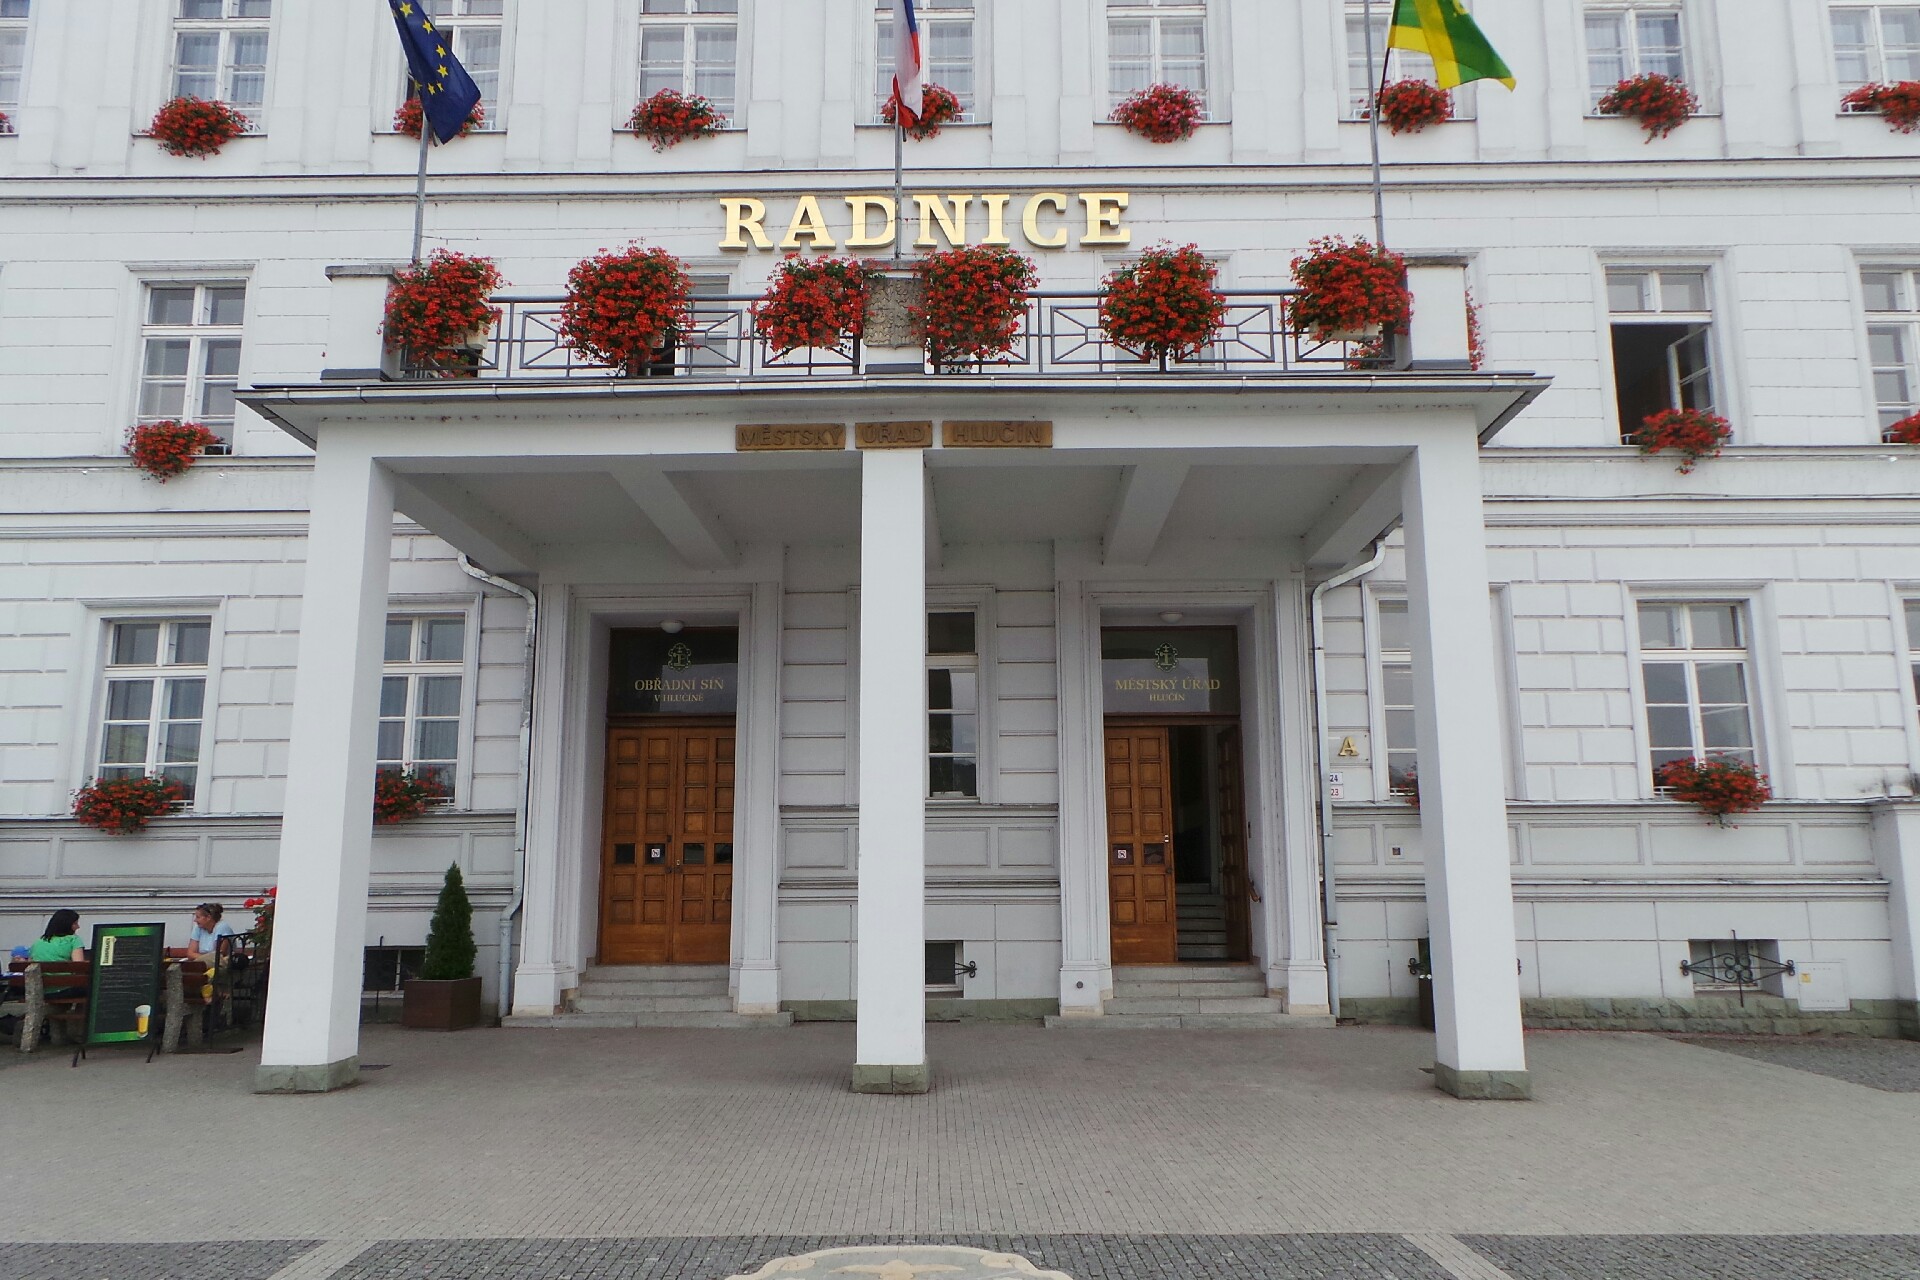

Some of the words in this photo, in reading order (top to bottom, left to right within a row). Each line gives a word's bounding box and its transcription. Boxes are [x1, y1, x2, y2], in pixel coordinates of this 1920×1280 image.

[719, 193, 1131, 251] RADNICE
[740, 424, 844, 446] MĚSTSKÝ
[861, 421, 925, 444] ÚŘAD
[952, 421, 1043, 443] HLUČÍN
[634, 676, 696, 691] OBŘADNÍ
[1115, 676, 1178, 690] MĚSTSKÝ
[1182, 676, 1221, 690] ÚŘAD
[654, 694, 662, 702] V
[1149, 692, 1185, 702] HLUČÍN
[1337, 736, 1360, 757] A
